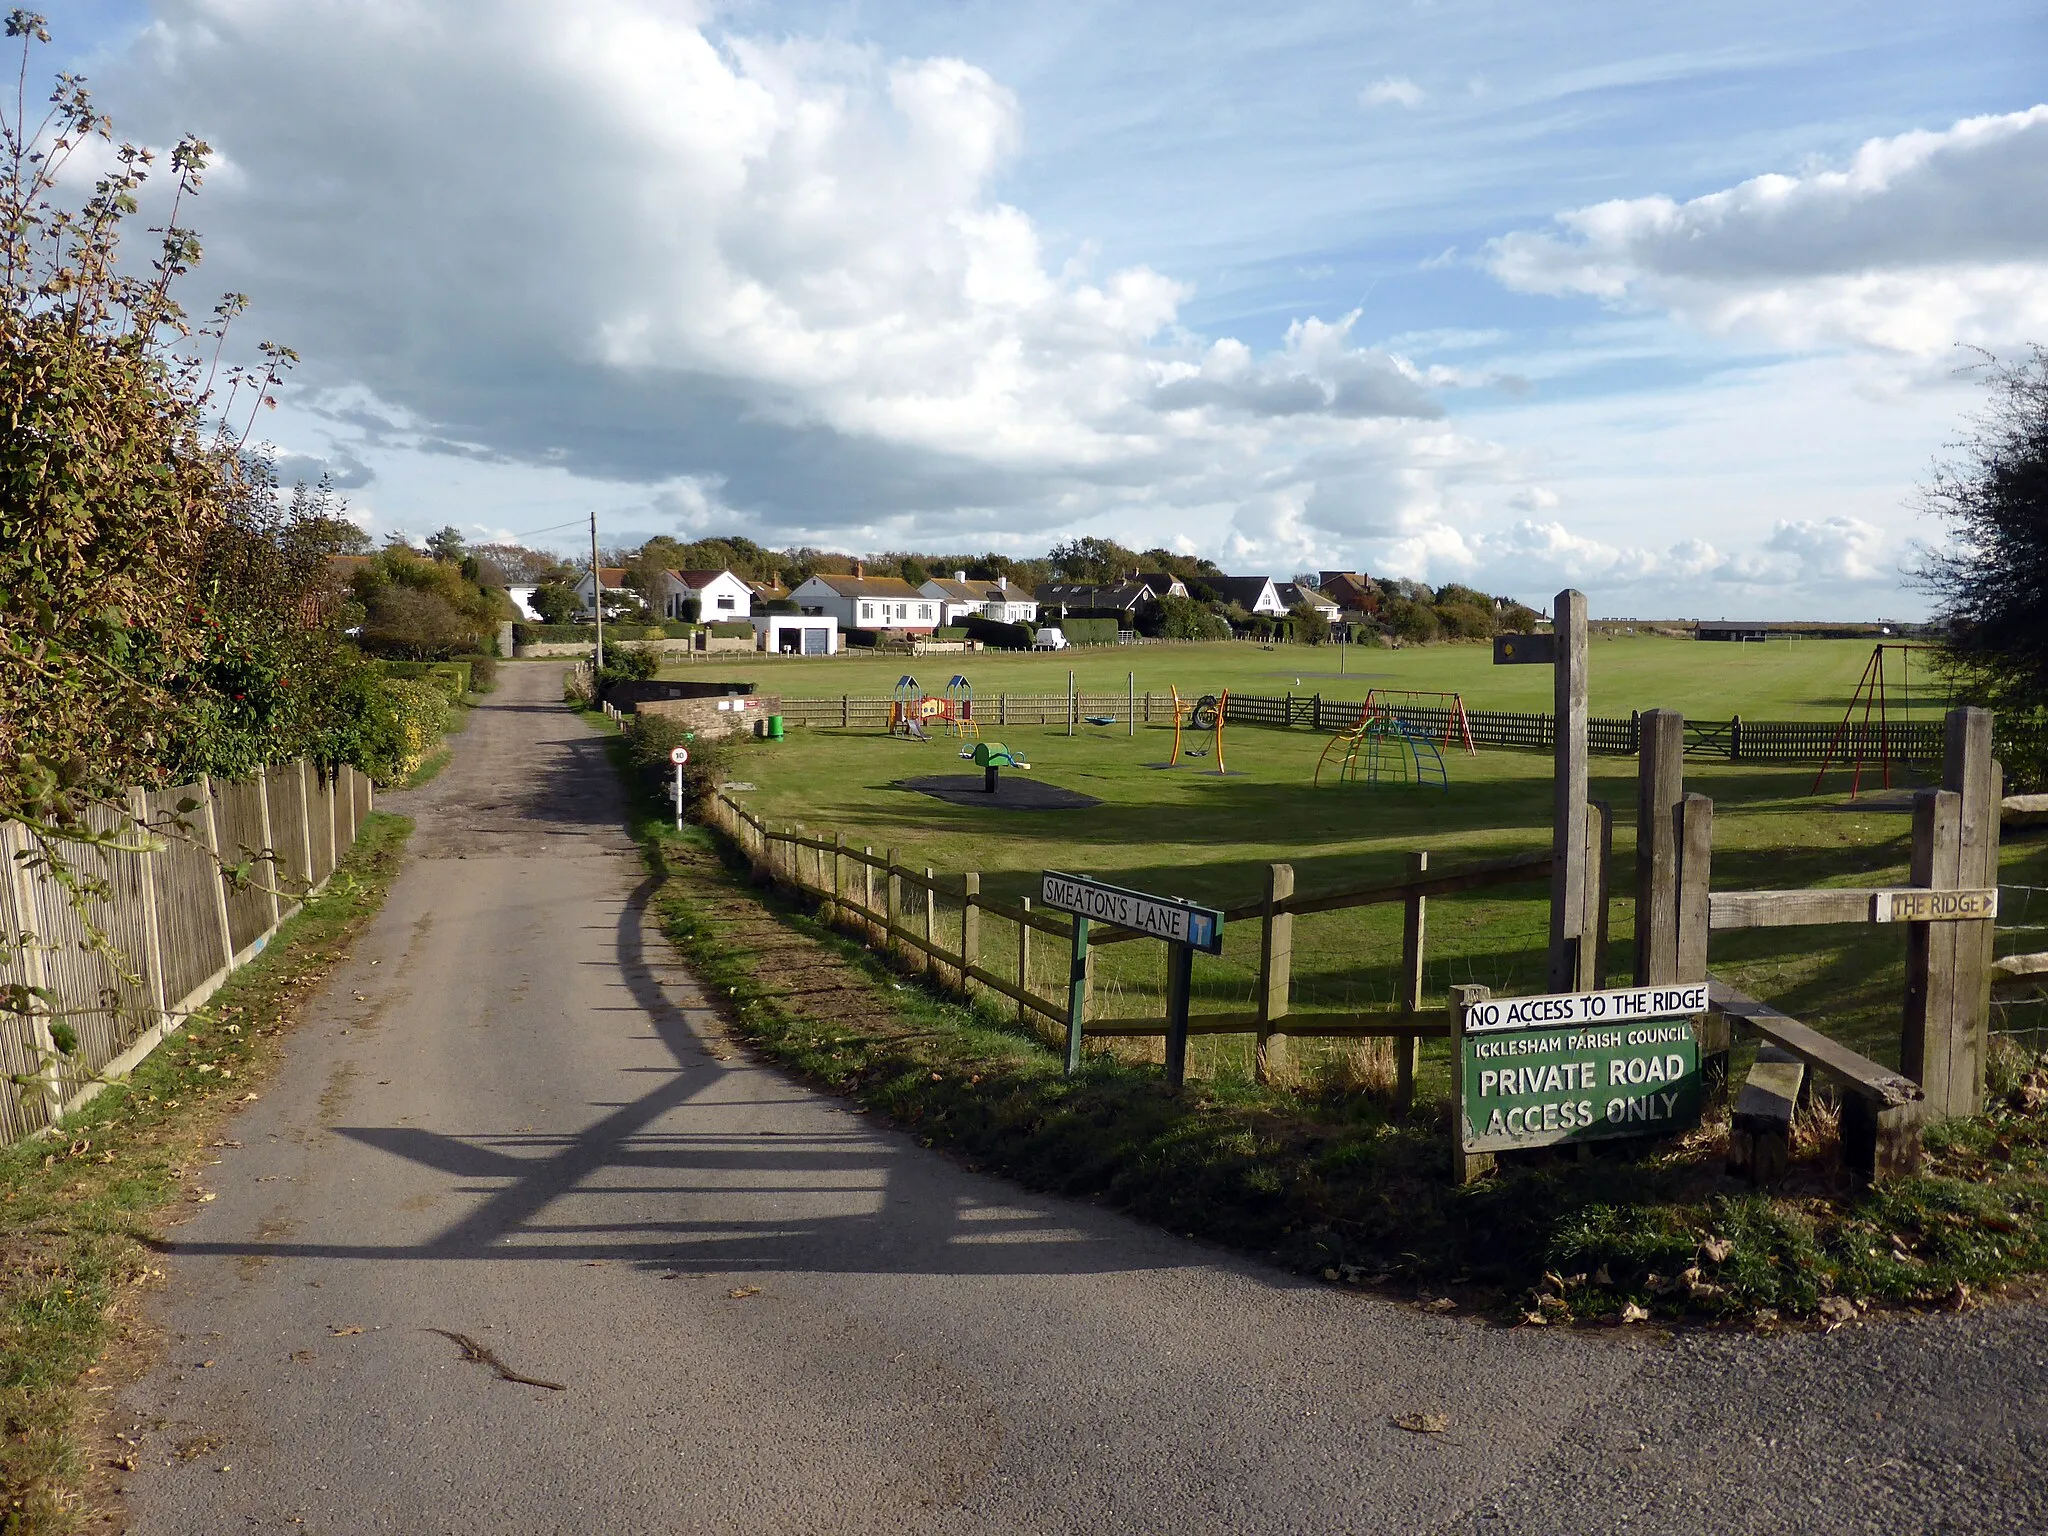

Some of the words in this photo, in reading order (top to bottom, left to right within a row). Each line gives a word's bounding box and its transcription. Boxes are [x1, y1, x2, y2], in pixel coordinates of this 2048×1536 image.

[1045, 879, 1128, 921] SMEATON'S
[1135, 902, 1181, 935] LANE
[1892, 895, 1925, 916] THE
[1931, 894, 1979, 914] RIDGE
[1470, 1005, 1499, 1027] NO
[1507, 1000, 1574, 1024] ACCESS
[1580, 996, 1606, 1018] TO
[1613, 993, 1647, 1015] THE
[1653, 988, 1705, 1012] RIDGE
[1475, 1036, 1561, 1059] ICKLESHAM
[1568, 1031, 1621, 1050] PARISH
[1628, 1026, 1689, 1046] COUNCIL
[1480, 1062, 1596, 1098] PRIVATE
[1609, 1054, 1685, 1086] ROAD
[1487, 1099, 1593, 1136] ACCESS
[1606, 1092, 1679, 1124] ONLY
